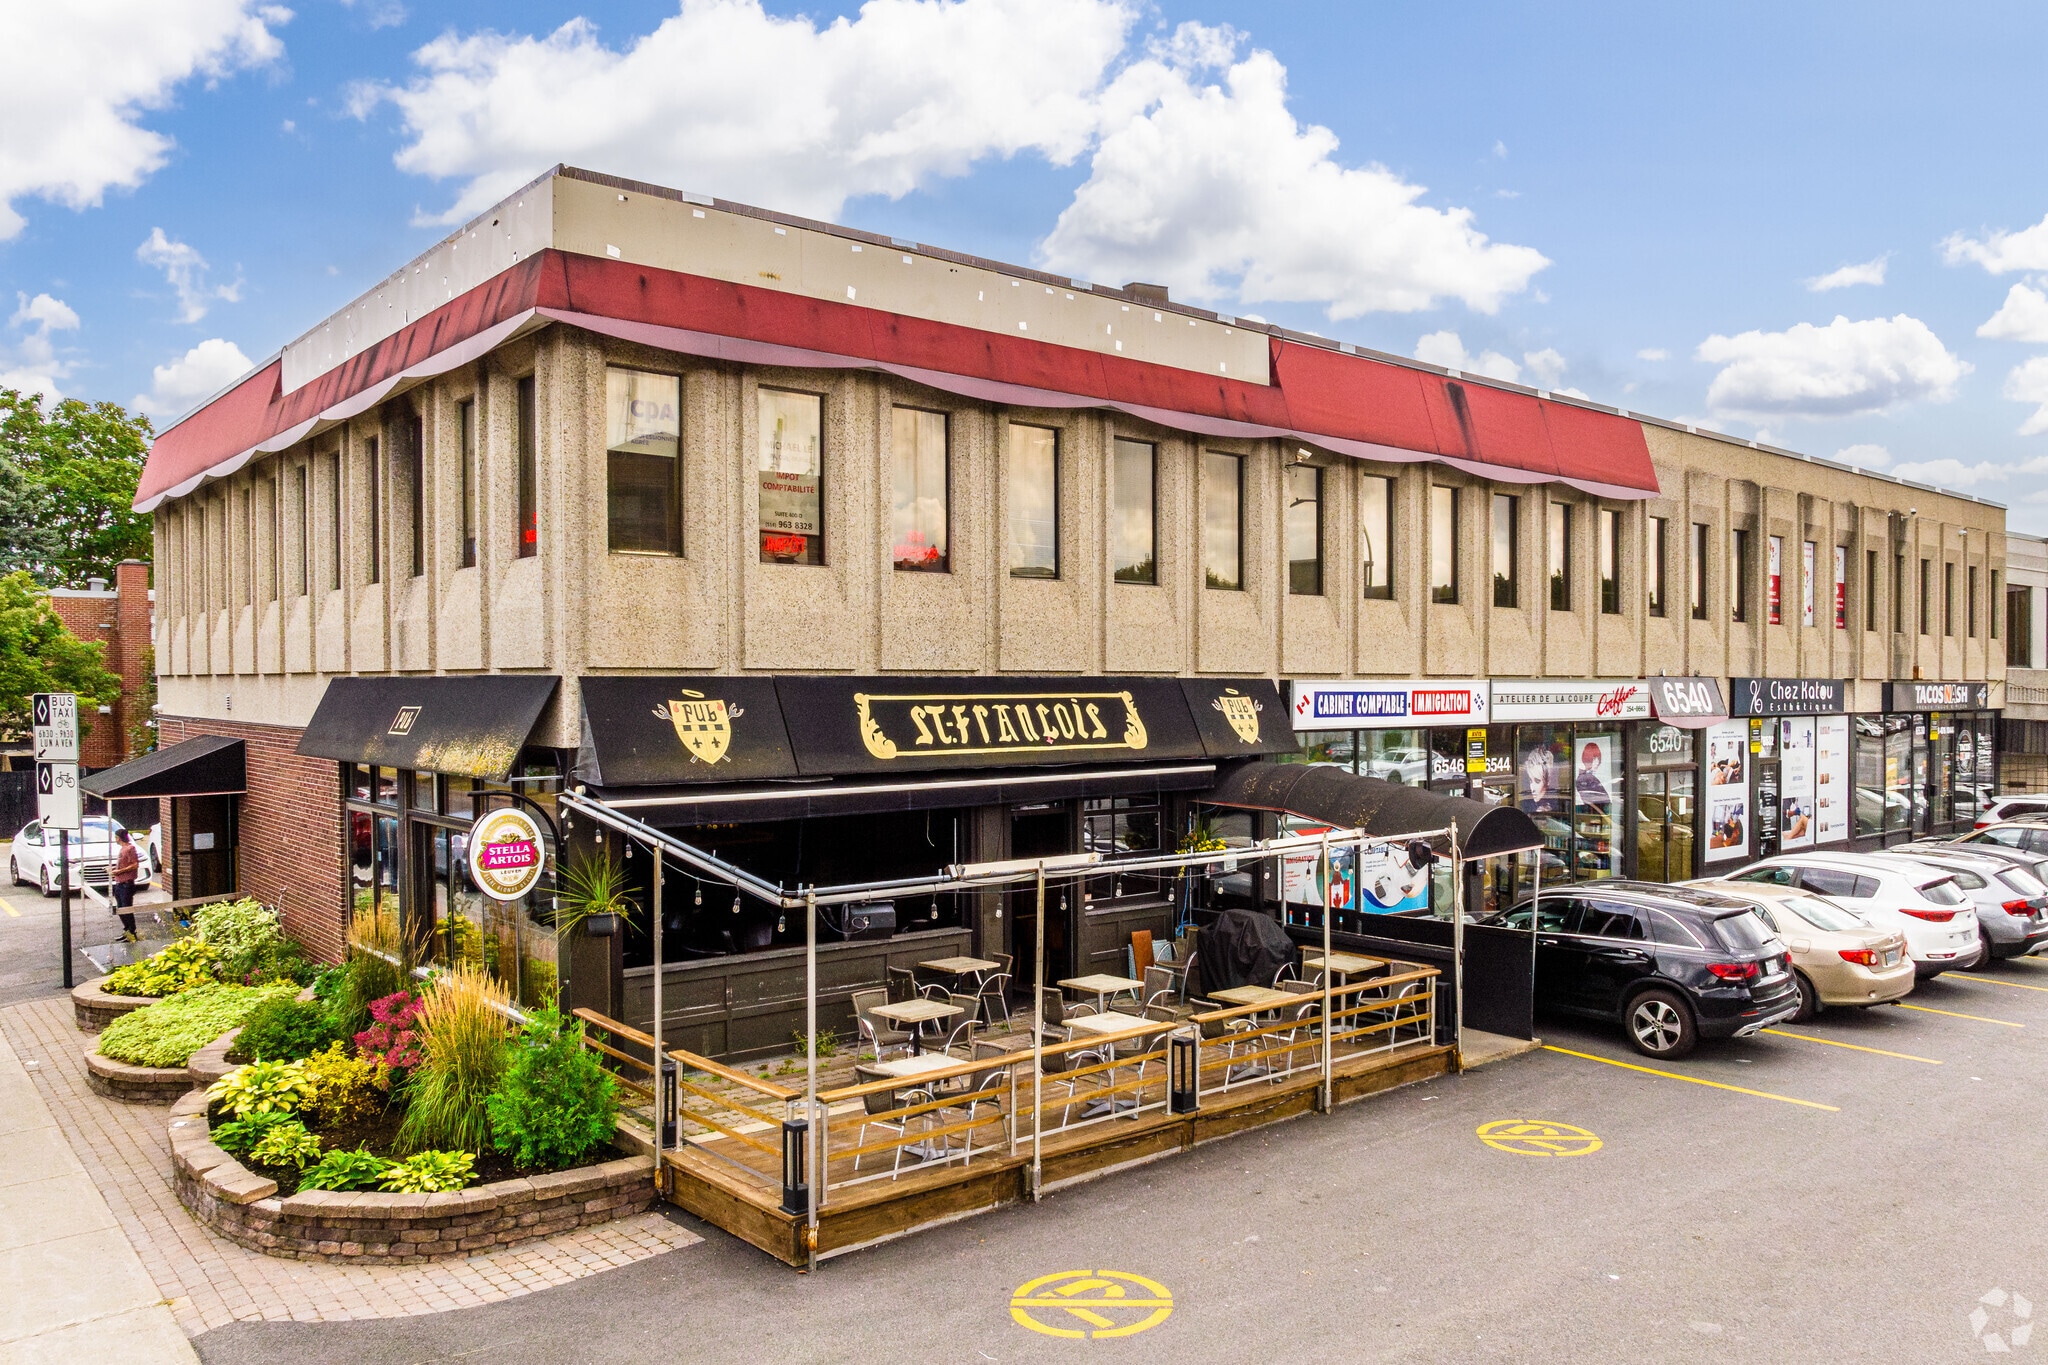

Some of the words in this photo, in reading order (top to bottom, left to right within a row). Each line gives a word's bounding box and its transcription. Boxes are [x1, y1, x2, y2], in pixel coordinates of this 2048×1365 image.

[762, 481, 815, 494] COMPTABILITÉ
[778, 520, 793, 529] 963
[794, 522, 813, 530] 8328
[1770, 681, 1798, 700] Chez
[1801, 681, 1833, 700] Katou
[51, 696, 73, 707] BUS
[1317, 694, 1354, 715] CABINET
[1356, 693, 1405, 714] COMPTABLE
[1414, 692, 1469, 712] IMMIGRATION
[1500, 695, 1536, 703] ATELIER
[1539, 695, 1550, 703] DE
[1568, 694, 1593, 702] COUPE
[1597, 685, 1638, 716] Coiffure
[1662, 681, 1713, 714] 6540
[52, 708, 74, 718] TAXI
[1769, 702, 1833, 712] Esthétique
[38, 730, 53, 738] 6h30
[59, 730, 74, 738] 9h30
[40, 739, 53, 747] LUN
[61, 739, 73, 747] VEN
[1649, 733, 1682, 753] 6540
[1433, 758, 1465, 774] 6546
[1485, 757, 1510, 773] 6544
[489, 844, 530, 856] STELLA
[489, 854, 531, 865] ARTOIS
